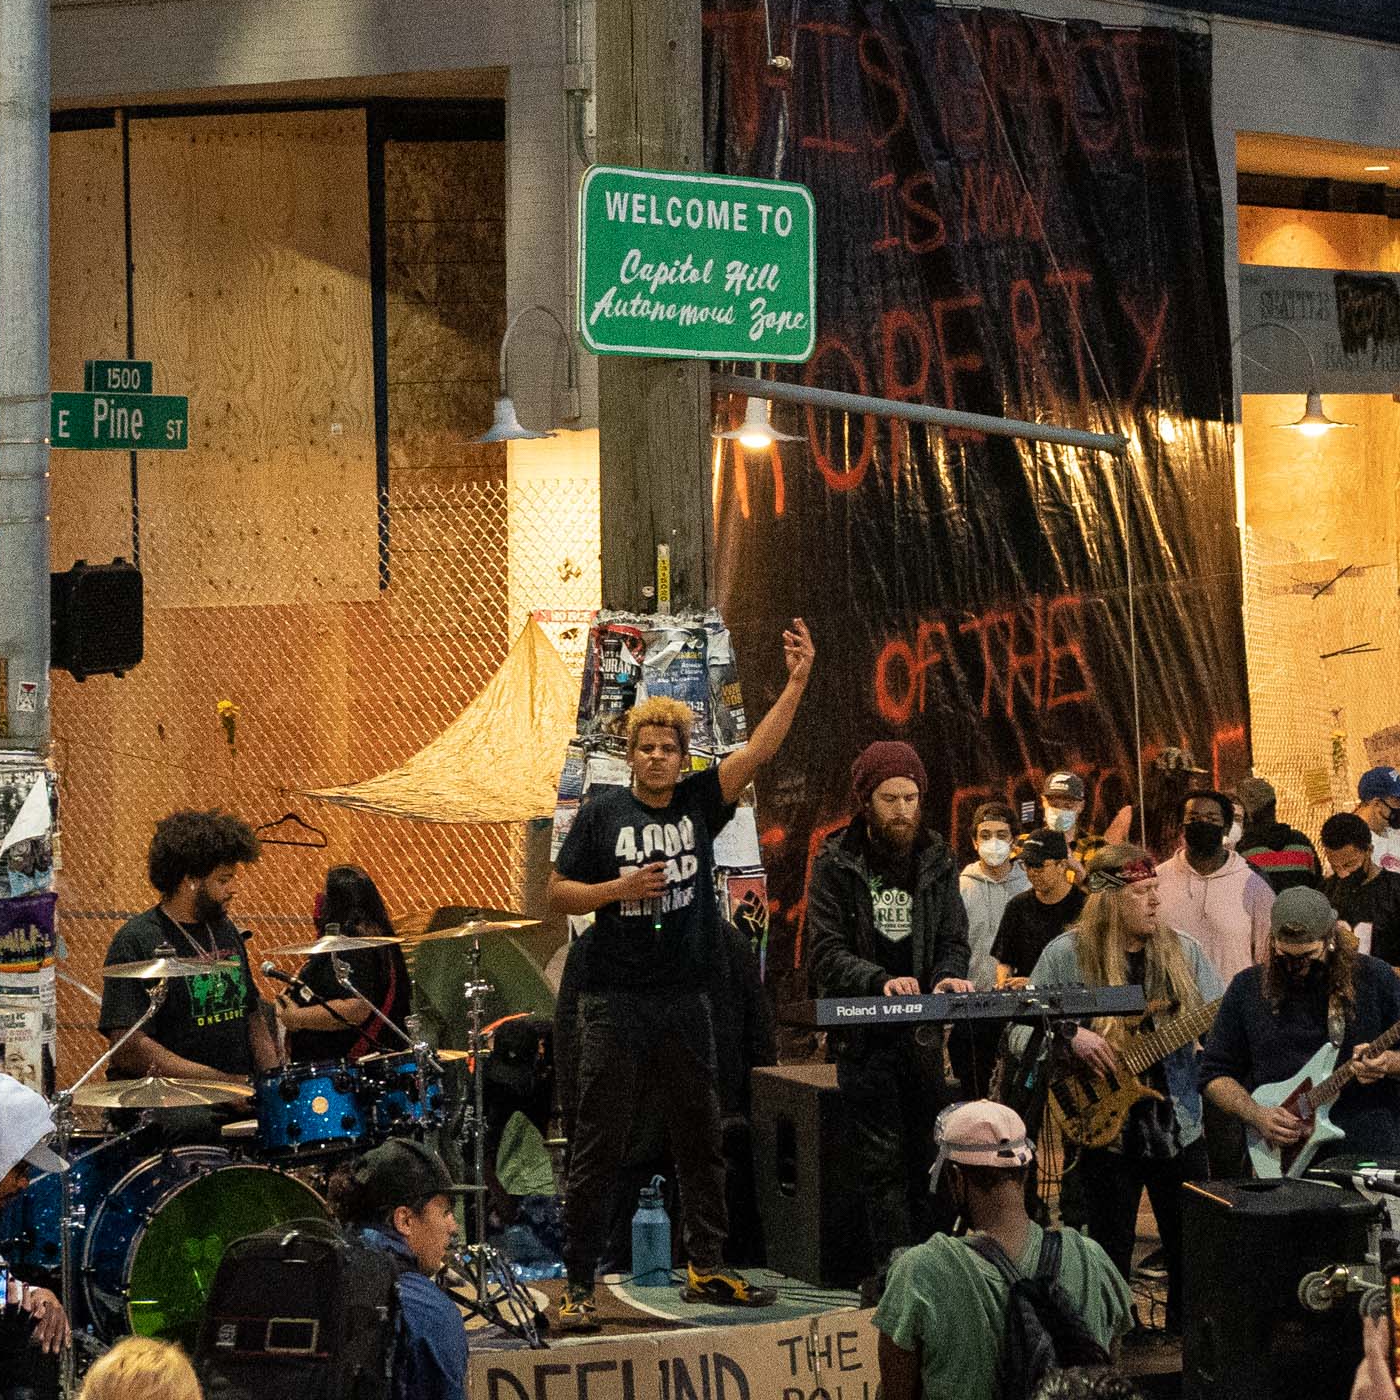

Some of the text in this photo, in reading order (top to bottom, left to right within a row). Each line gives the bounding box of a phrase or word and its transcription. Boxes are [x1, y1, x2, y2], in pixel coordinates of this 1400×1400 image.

[605, 191, 793, 237] WELCOME TO
[868, 172, 946, 253] IS
[620, 248, 781, 296] Capitol Hill
[589, 286, 808, 341] Autonomous Zone
[107, 368, 141, 390] 1500
[58, 397, 183, 441] E Pine ST
[872, 620, 947, 726] OF
[615, 815, 696, 863] 4,000
[198, 1015, 221, 1026] ONE
[836, 1003, 923, 1018] Roland VR-09
[777, 1330, 863, 1376] THE
